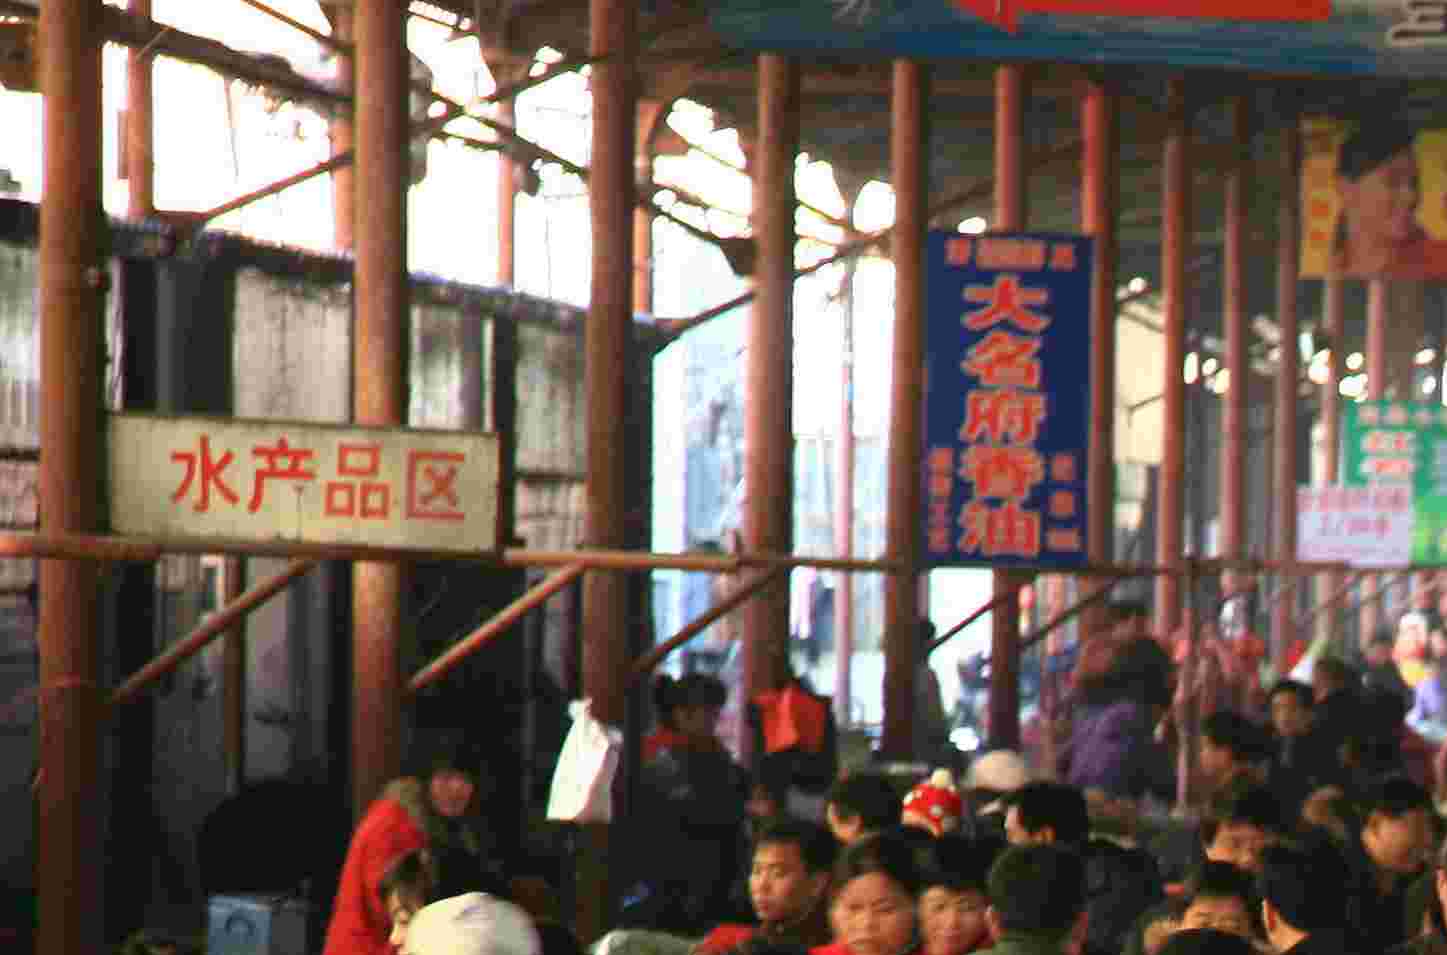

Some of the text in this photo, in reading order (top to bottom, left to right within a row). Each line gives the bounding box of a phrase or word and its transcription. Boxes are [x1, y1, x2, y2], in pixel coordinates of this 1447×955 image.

[170, 432, 466, 521] 水产品区
[958, 274, 1052, 556] 大名府香油
